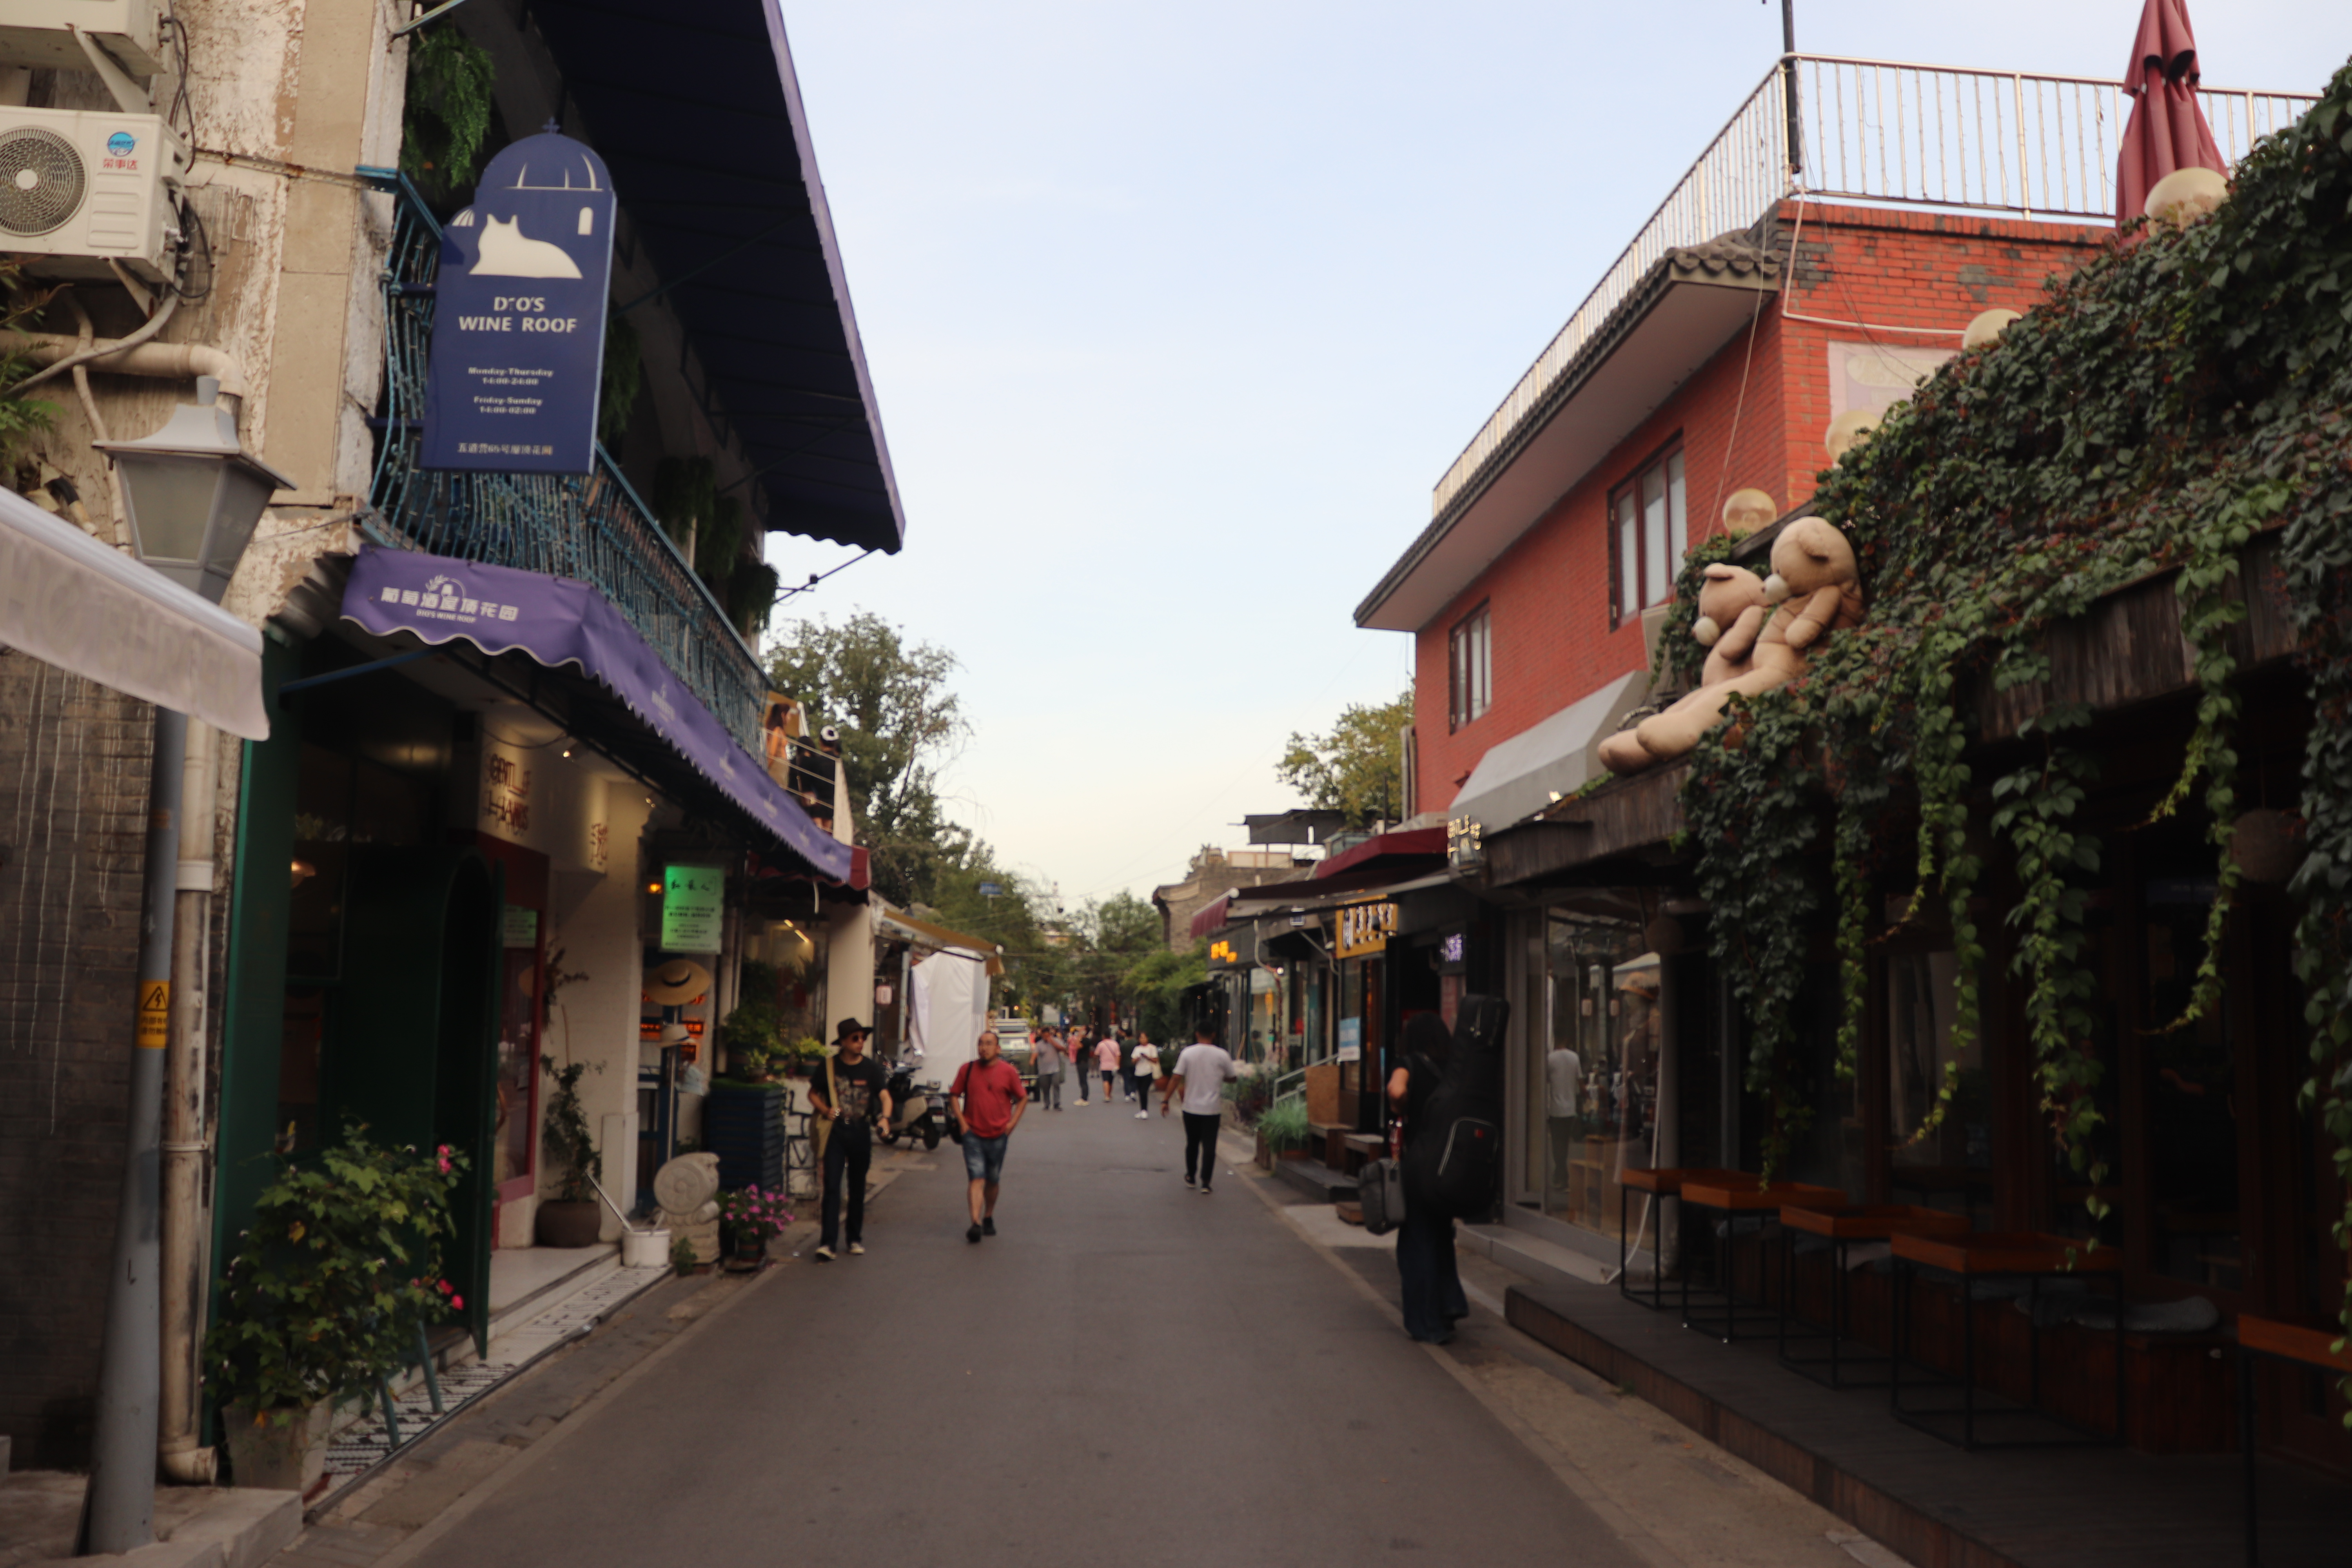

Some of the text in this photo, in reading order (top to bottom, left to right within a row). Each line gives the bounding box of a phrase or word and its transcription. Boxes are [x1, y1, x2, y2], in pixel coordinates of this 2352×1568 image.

[459, 316, 577, 333] WINE ROOF
[381, 587, 519, 622] 葡萄酒屋顶花园
